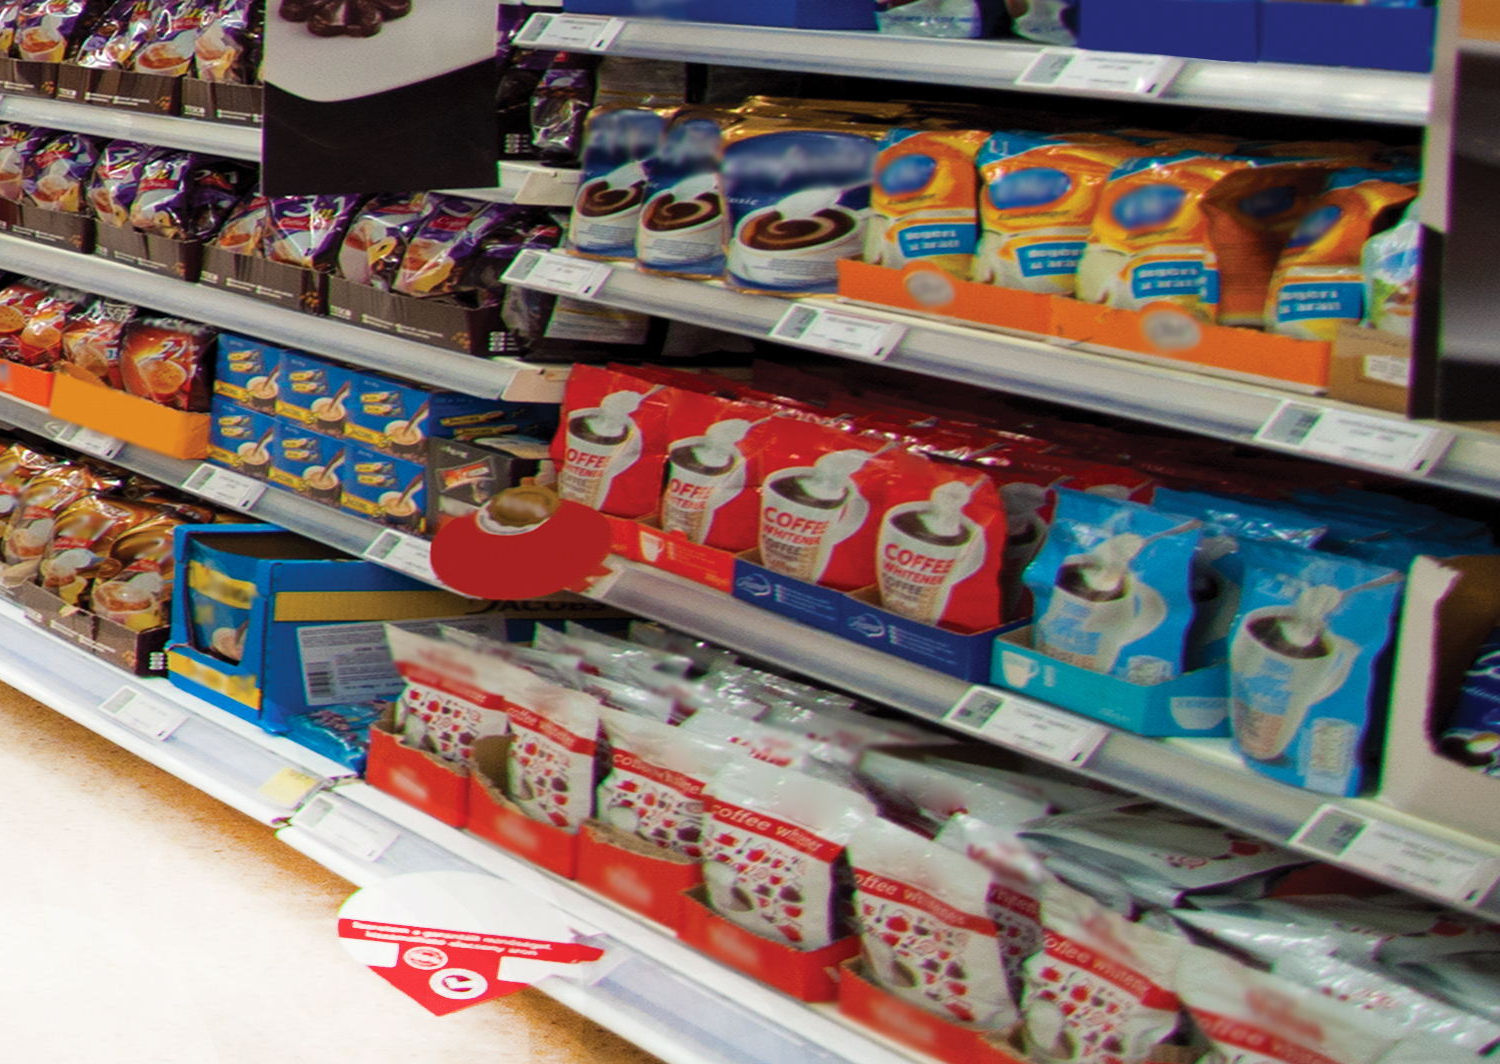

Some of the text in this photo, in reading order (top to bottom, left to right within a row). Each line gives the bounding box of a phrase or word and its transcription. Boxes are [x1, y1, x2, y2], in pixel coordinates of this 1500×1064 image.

[763, 506, 830, 535] COFFEE
[884, 543, 956, 575] COFFEE
[711, 801, 772, 832] coffee
